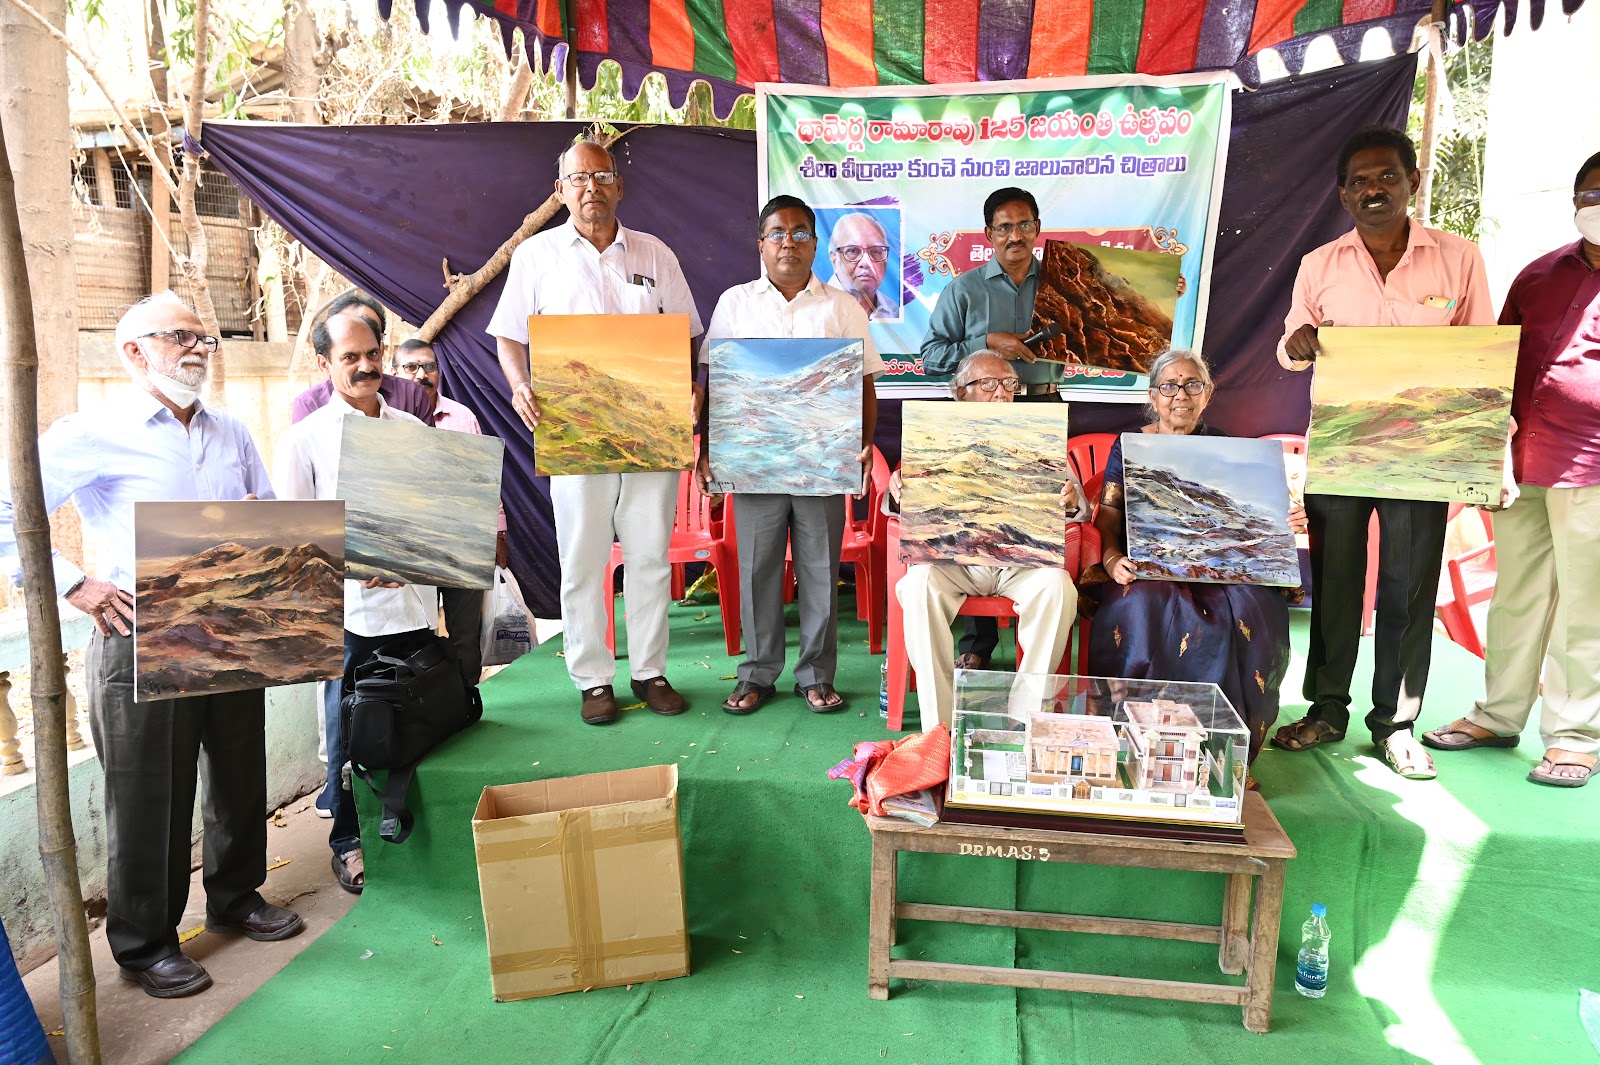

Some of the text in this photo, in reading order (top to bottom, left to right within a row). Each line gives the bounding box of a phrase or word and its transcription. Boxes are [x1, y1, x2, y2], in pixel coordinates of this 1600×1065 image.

[797, 104, 1192, 151] దామెర్ల రామారావు 125 జయంతి ఉత్సవం
[799, 155, 838, 179] శీలా
[907, 157, 956, 178] కుంచె
[960, 156, 1011, 178] నుంచి
[1014, 154, 1115, 177] జాలువారిన
[1119, 155, 1188, 177] చిత్రాలు
